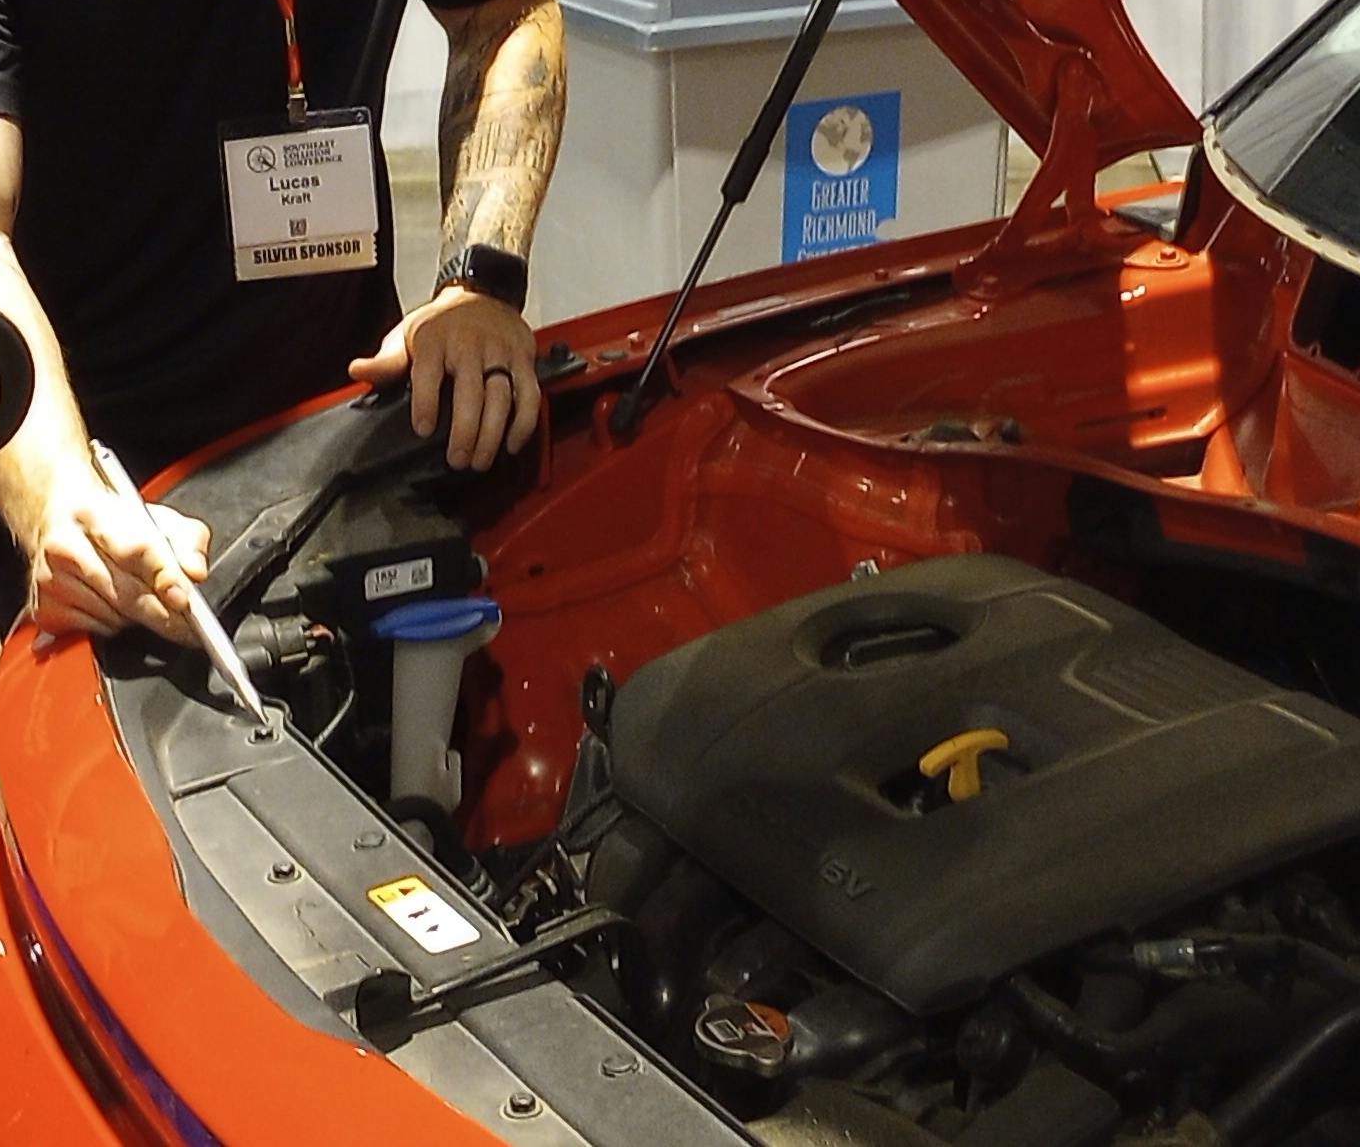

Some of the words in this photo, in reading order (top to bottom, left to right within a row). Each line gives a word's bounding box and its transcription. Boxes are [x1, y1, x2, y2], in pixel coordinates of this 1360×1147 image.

[268, 175, 321, 192] Lucas
[811, 178, 870, 212] GREATER
[802, 209, 876, 245] RICHMOND
[253, 244, 298, 264] SILVER
[300, 240, 361, 260] SPONSOR
